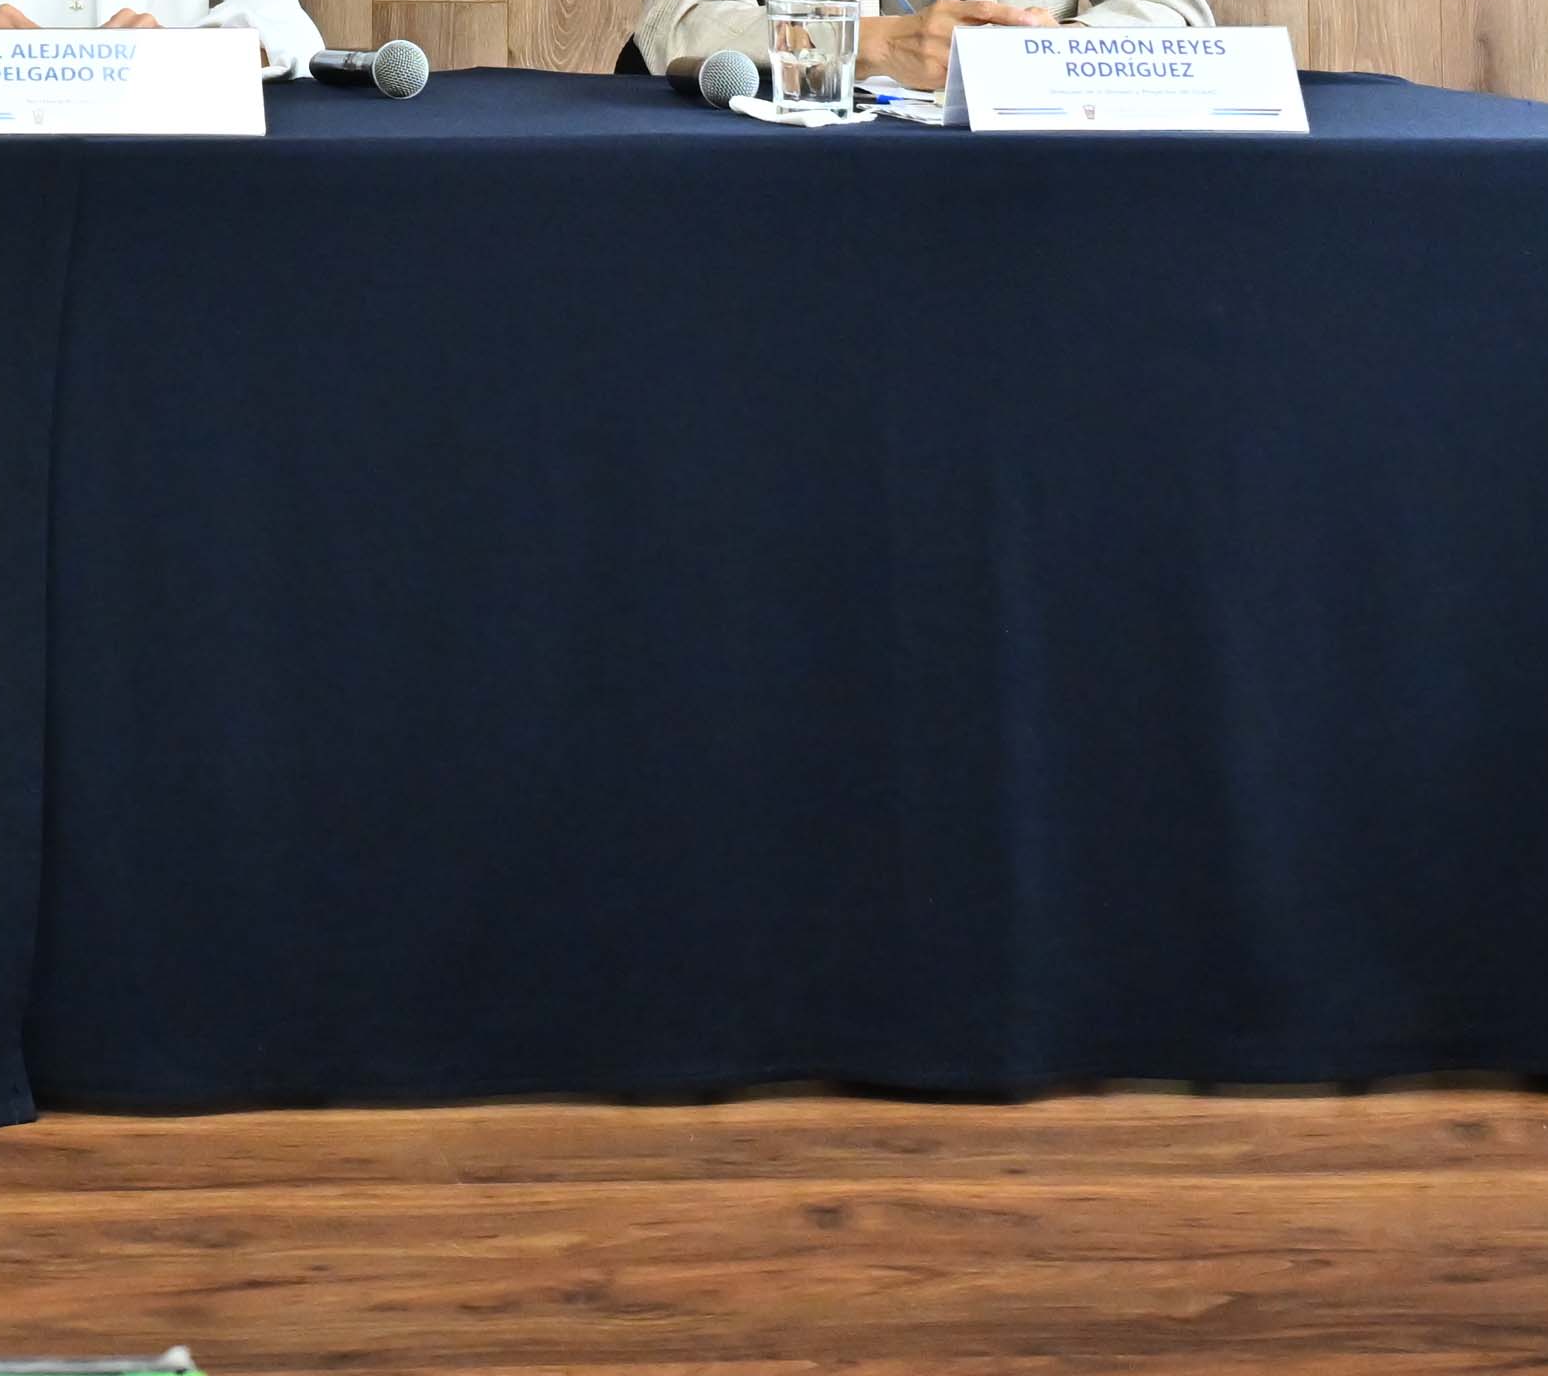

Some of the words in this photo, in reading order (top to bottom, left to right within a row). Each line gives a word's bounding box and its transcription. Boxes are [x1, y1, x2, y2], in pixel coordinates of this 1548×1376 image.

[1024, 39, 1061, 56] DR.
[1068, 35, 1154, 56] RAMÓN
[1162, 39, 1227, 56] REYES
[1065, 58, 1194, 78] RODRÍGUEZ
